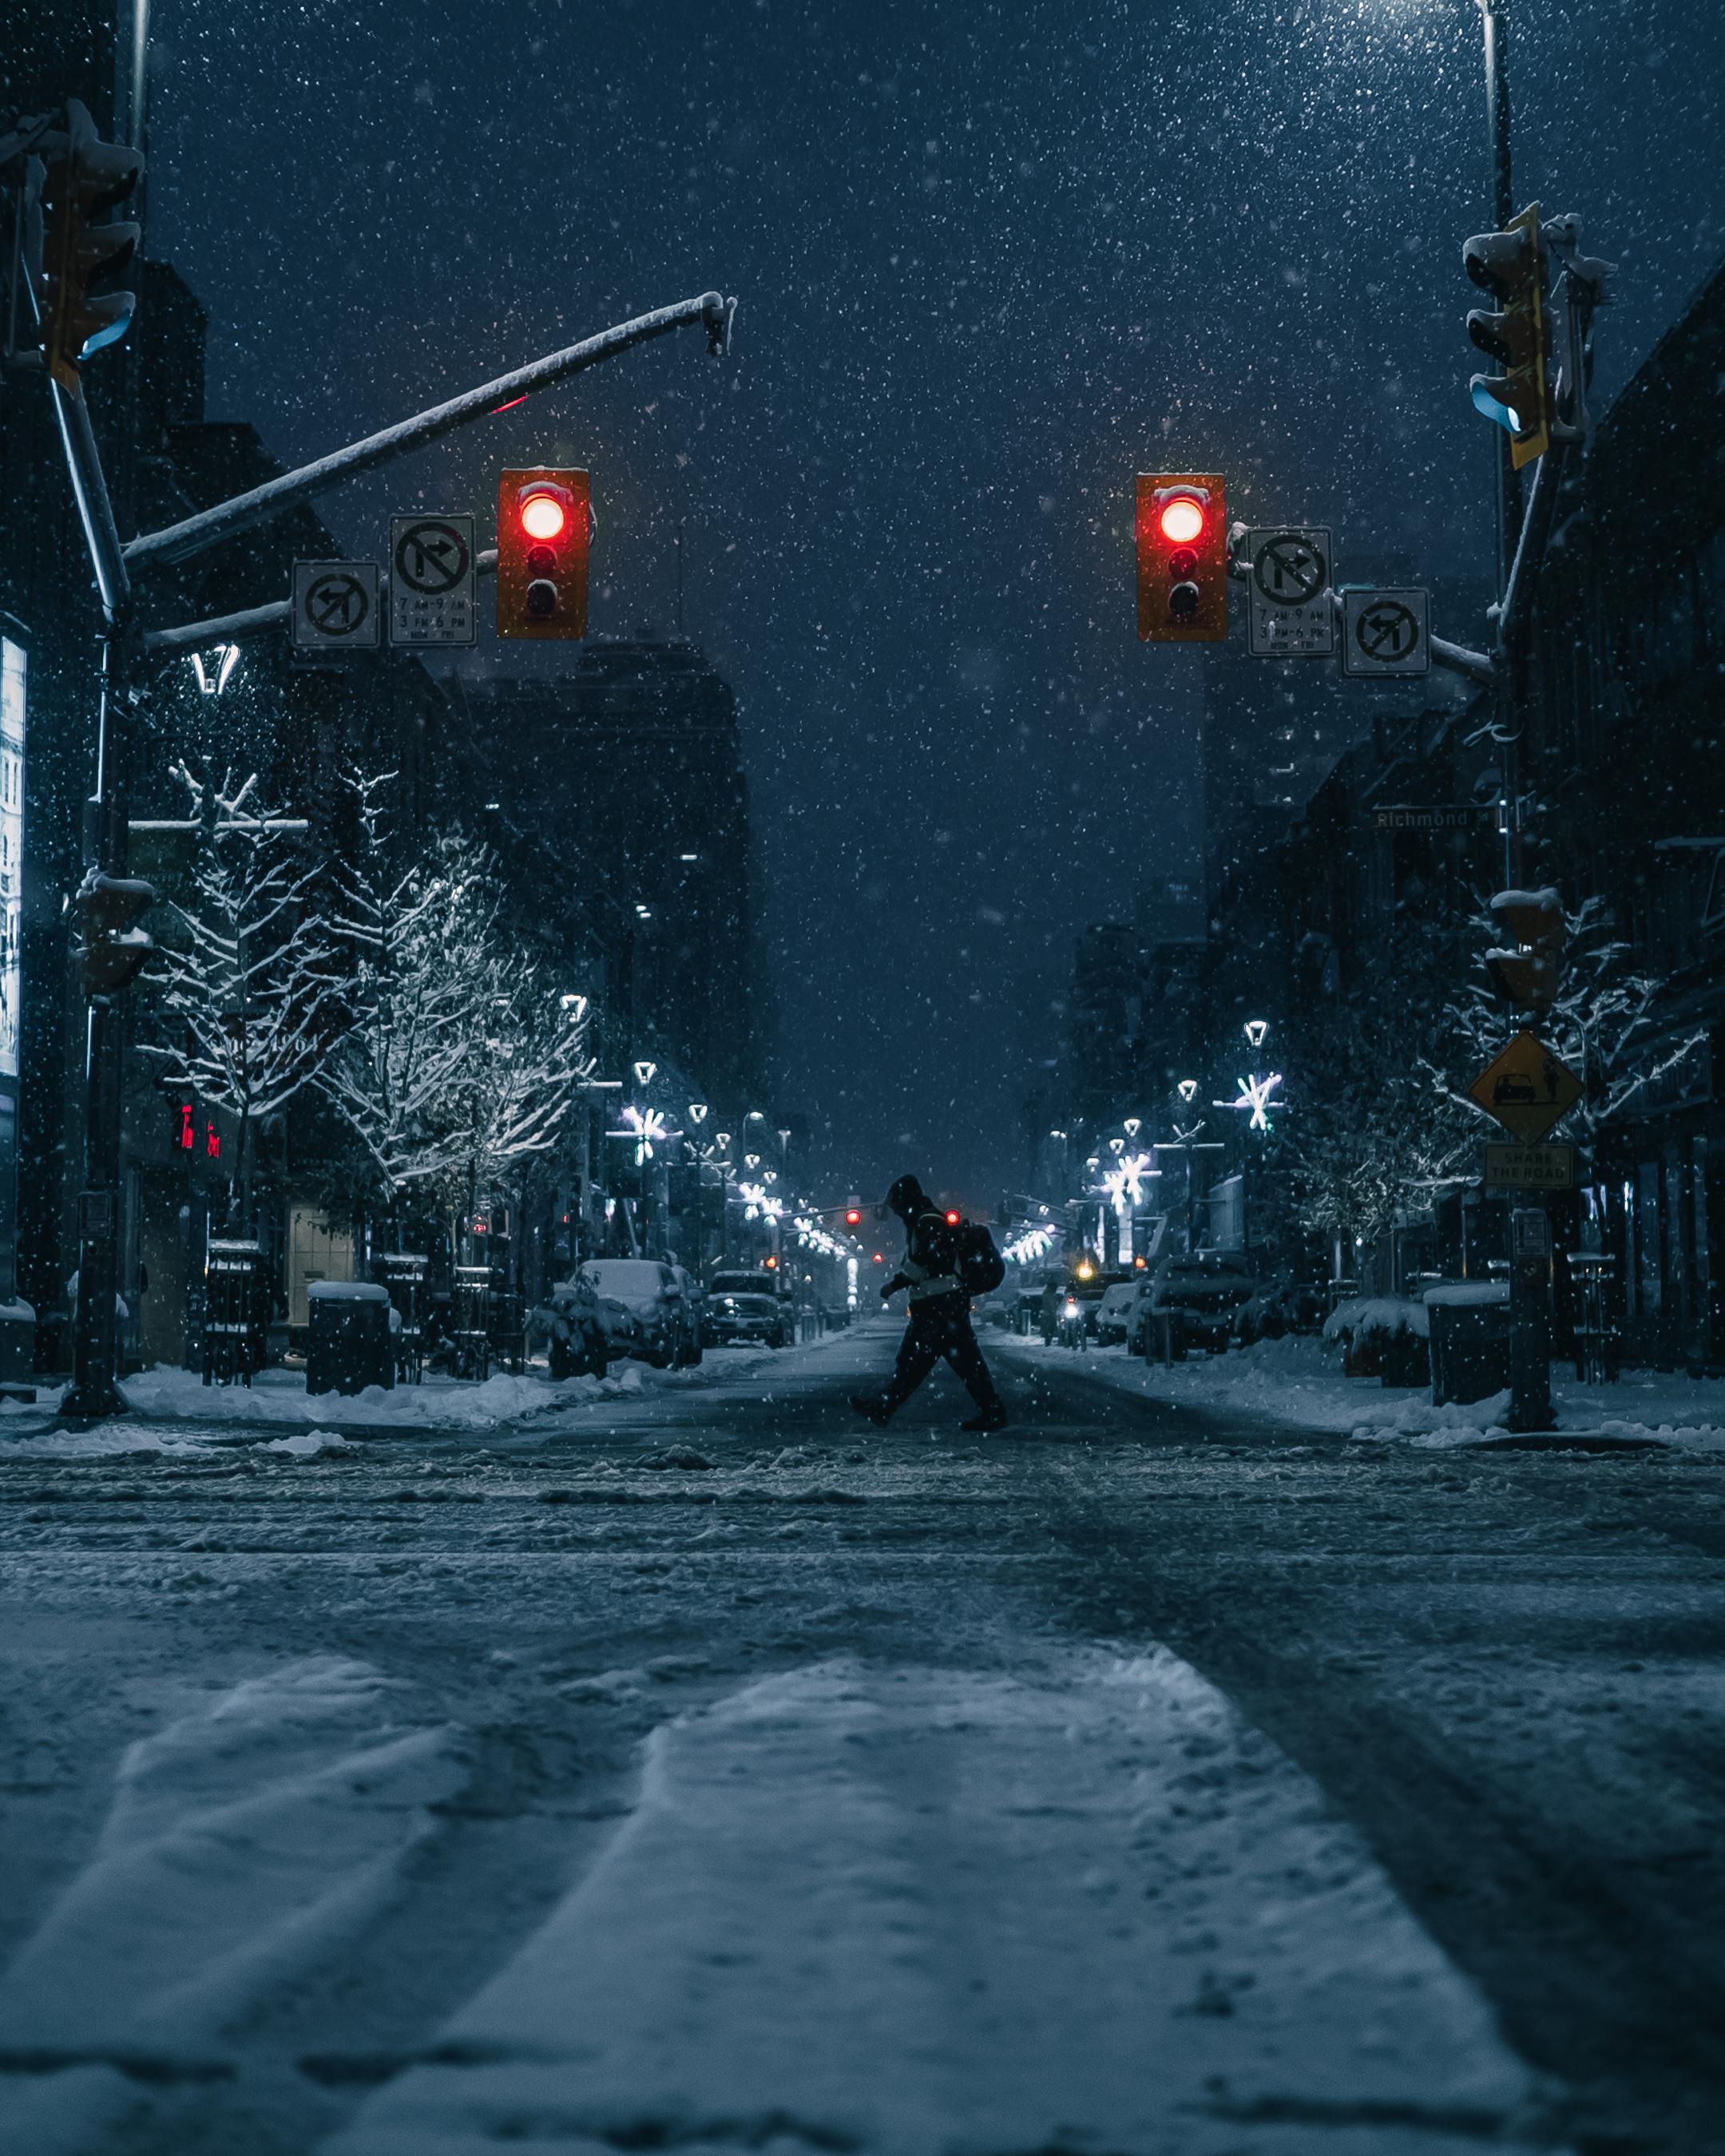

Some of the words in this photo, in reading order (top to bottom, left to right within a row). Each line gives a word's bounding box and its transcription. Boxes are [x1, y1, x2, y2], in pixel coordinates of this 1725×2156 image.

[400, 597, 408, 610] 7
[1259, 608, 1267, 621] 7
[1310, 611, 1323, 620] AM
[400, 615, 407, 628] 3
[451, 617, 465, 627] PM
[1260, 626, 1267, 639] 3
[1377, 811, 1468, 827] Richmond
[1505, 1152, 1552, 1164] SHARE
[1492, 1167, 1519, 1179] THE
[1524, 1167, 1564, 1179] ROAD
